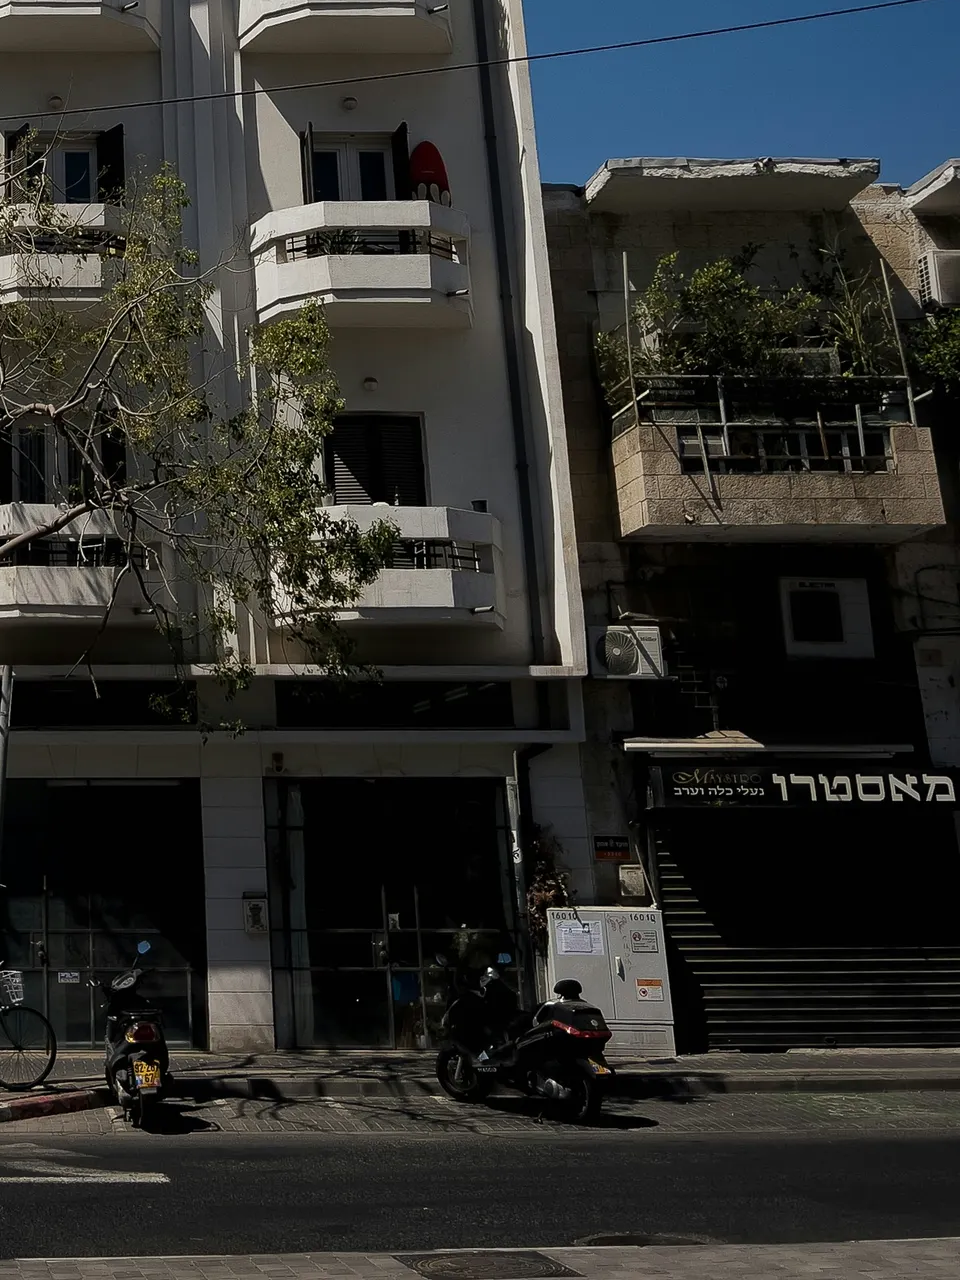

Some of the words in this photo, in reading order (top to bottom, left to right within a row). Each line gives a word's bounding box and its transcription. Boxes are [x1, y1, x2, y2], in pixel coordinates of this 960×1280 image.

[673, 787, 705, 796] וערב
[708, 785, 734, 796] כלה
[736, 785, 765, 796] נעלי
[772, 773, 956, 802] מאסטרו
[551, 912, 578, 920] 16010
